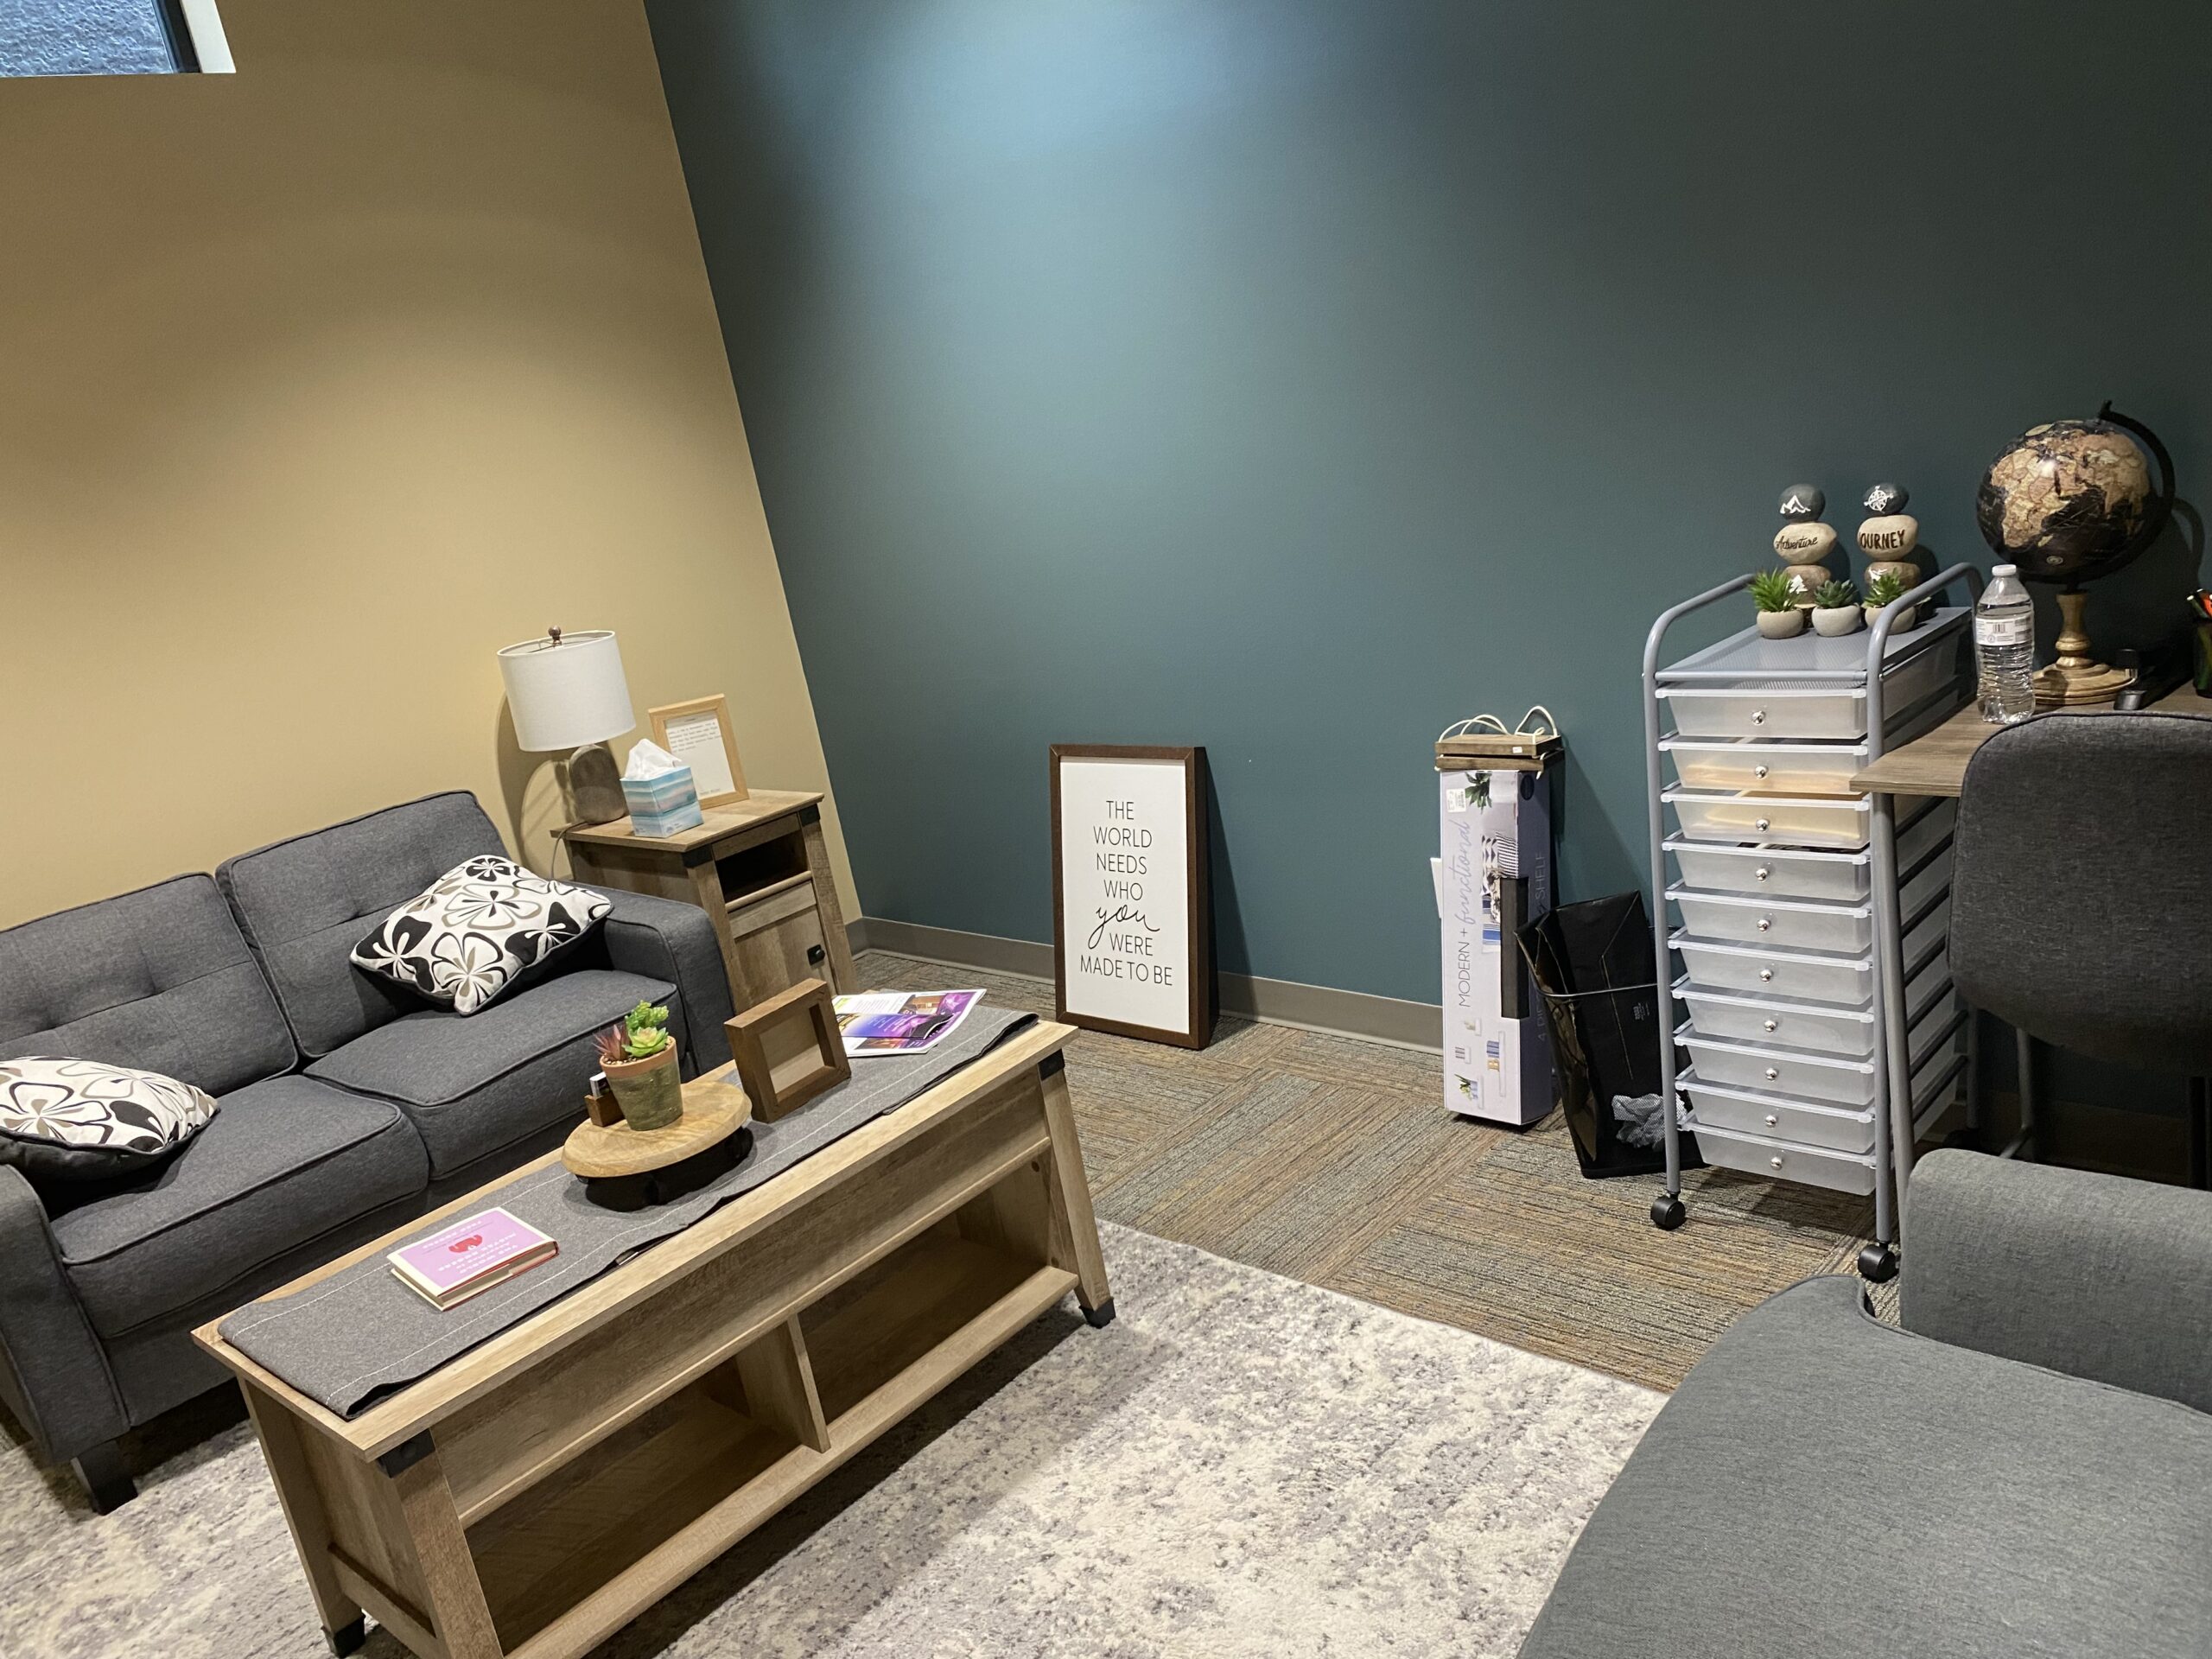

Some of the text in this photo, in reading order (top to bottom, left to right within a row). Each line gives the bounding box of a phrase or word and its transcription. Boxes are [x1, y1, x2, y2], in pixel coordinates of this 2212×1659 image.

[1776, 535, 1818, 550] Adventure
[1859, 529, 1905, 550] OURNEY
[1106, 800, 1135, 820] THE
[1093, 825, 1153, 849] WORLD
[1096, 853, 1147, 875] NEEDS
[1448, 819, 1476, 925] functional
[1535, 851, 1546, 899] SHELF
[1103, 879, 1143, 901] WHO
[1087, 904, 1160, 950] you
[1109, 932, 1154, 957] WERE
[1080, 955, 1173, 986] MADE TO BE
[1458, 941, 1471, 1007] MODERN
